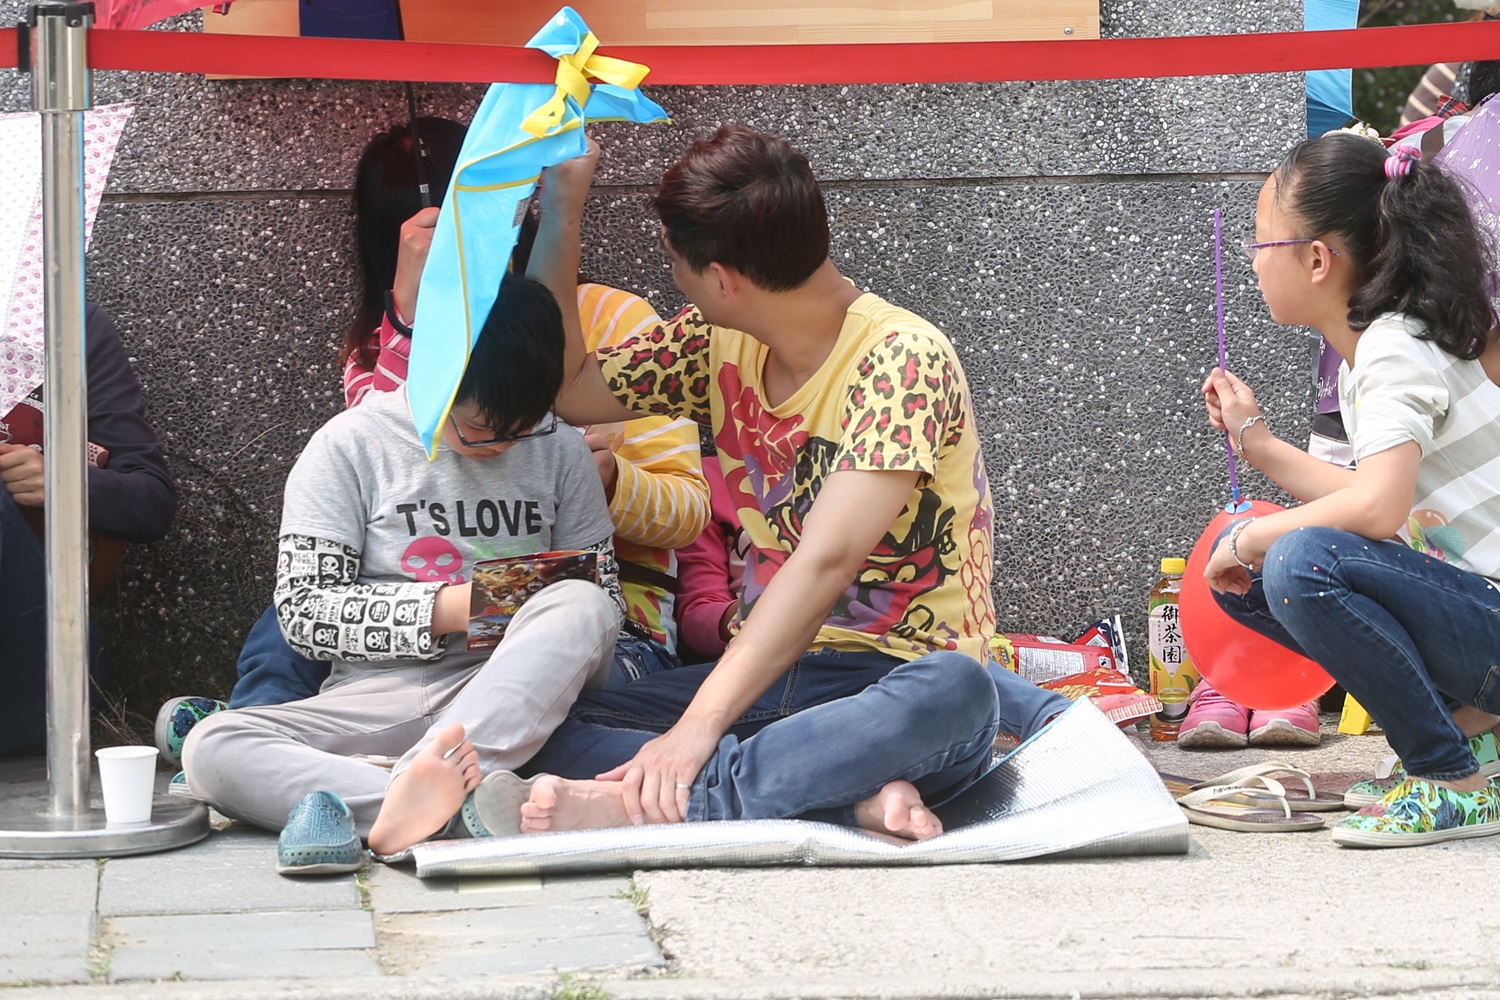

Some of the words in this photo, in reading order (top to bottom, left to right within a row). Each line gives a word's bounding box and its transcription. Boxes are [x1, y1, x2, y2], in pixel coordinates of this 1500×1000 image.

[396, 499, 450, 537] T'S
[456, 499, 542, 537] LOVE
[1161, 605, 1182, 664] 御茶園
